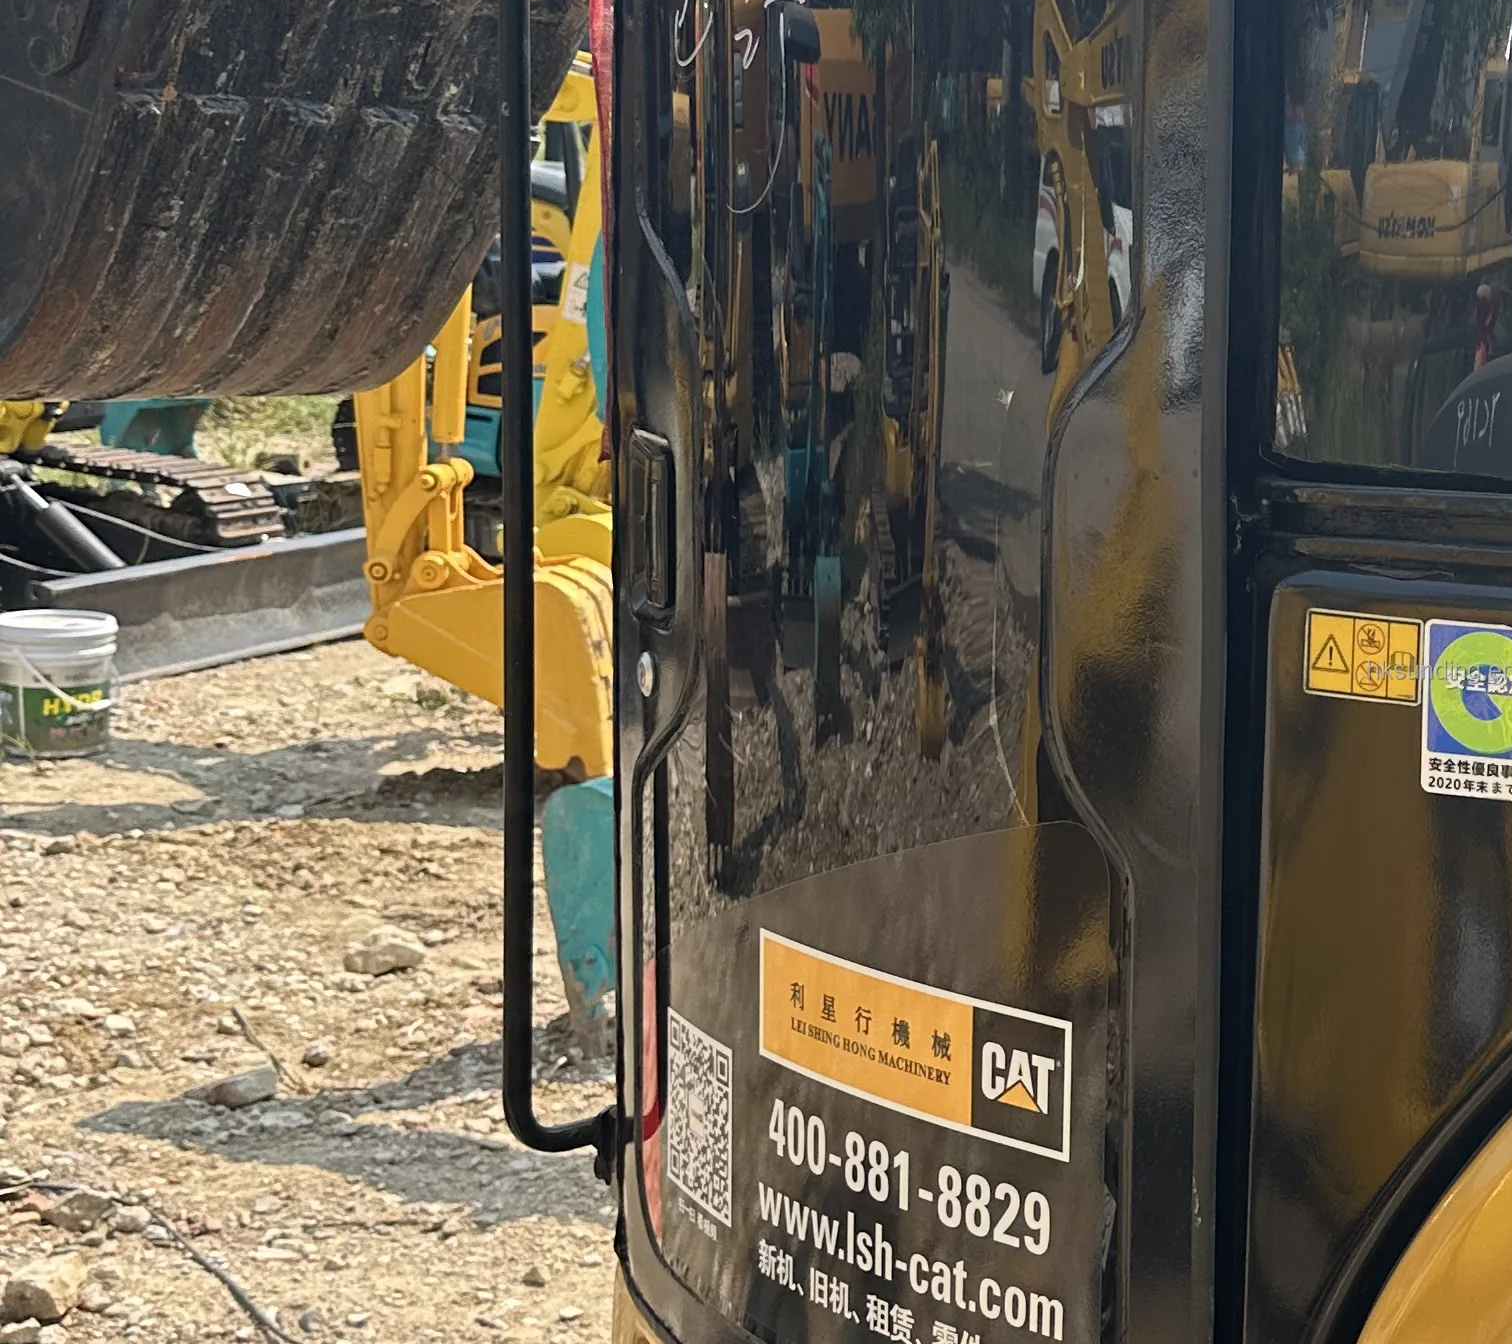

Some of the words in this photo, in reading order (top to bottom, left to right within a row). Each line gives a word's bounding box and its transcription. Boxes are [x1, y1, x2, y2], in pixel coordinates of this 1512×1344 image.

[791, 1017, 806, 1034] LEI
[808, 1024, 841, 1049] SHING
[842, 1037, 876, 1061] HONG
[877, 1050, 952, 1086] MACHINERY
[981, 1041, 1056, 1115] CAT
[768, 1098, 1051, 1256] 400-881-8829
[758, 1181, 1065, 1342] www.lsh-cat.com
